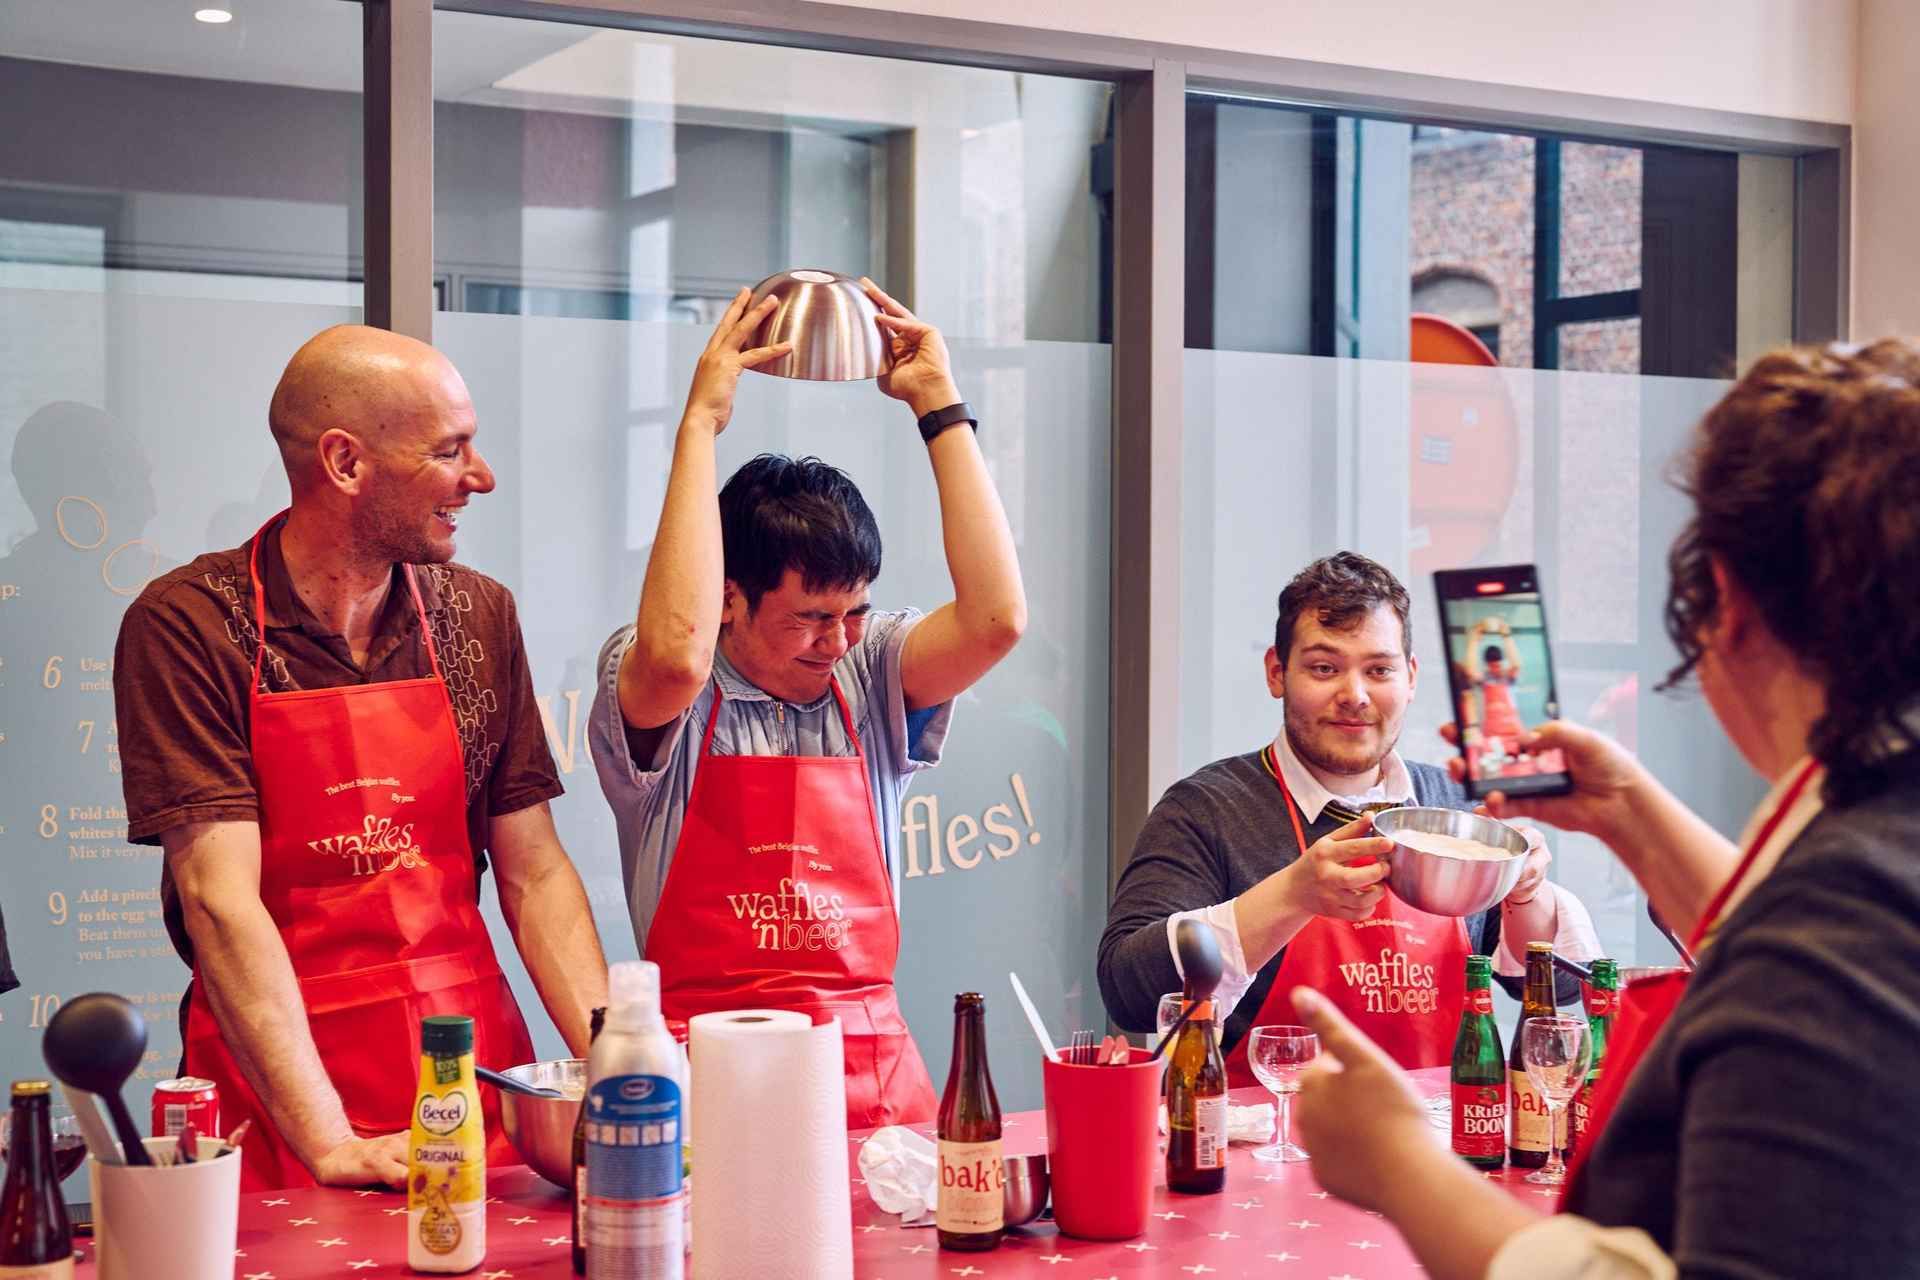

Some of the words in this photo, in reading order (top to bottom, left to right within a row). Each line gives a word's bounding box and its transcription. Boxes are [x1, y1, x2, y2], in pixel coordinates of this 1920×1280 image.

[43, 656, 64, 689] 6
[79, 720, 95, 753] 7
[40, 804, 59, 839] 8
[69, 806, 102, 820] Fold
[901, 773, 1041, 878] fles!
[307, 814, 414, 856] waffles
[48, 891, 68, 926] 9
[727, 877, 845, 921] waffles
[1338, 948, 1434, 989] waffles
[423, 1104, 460, 1120] Becel
[415, 1148, 466, 1163] ORIGINAL
